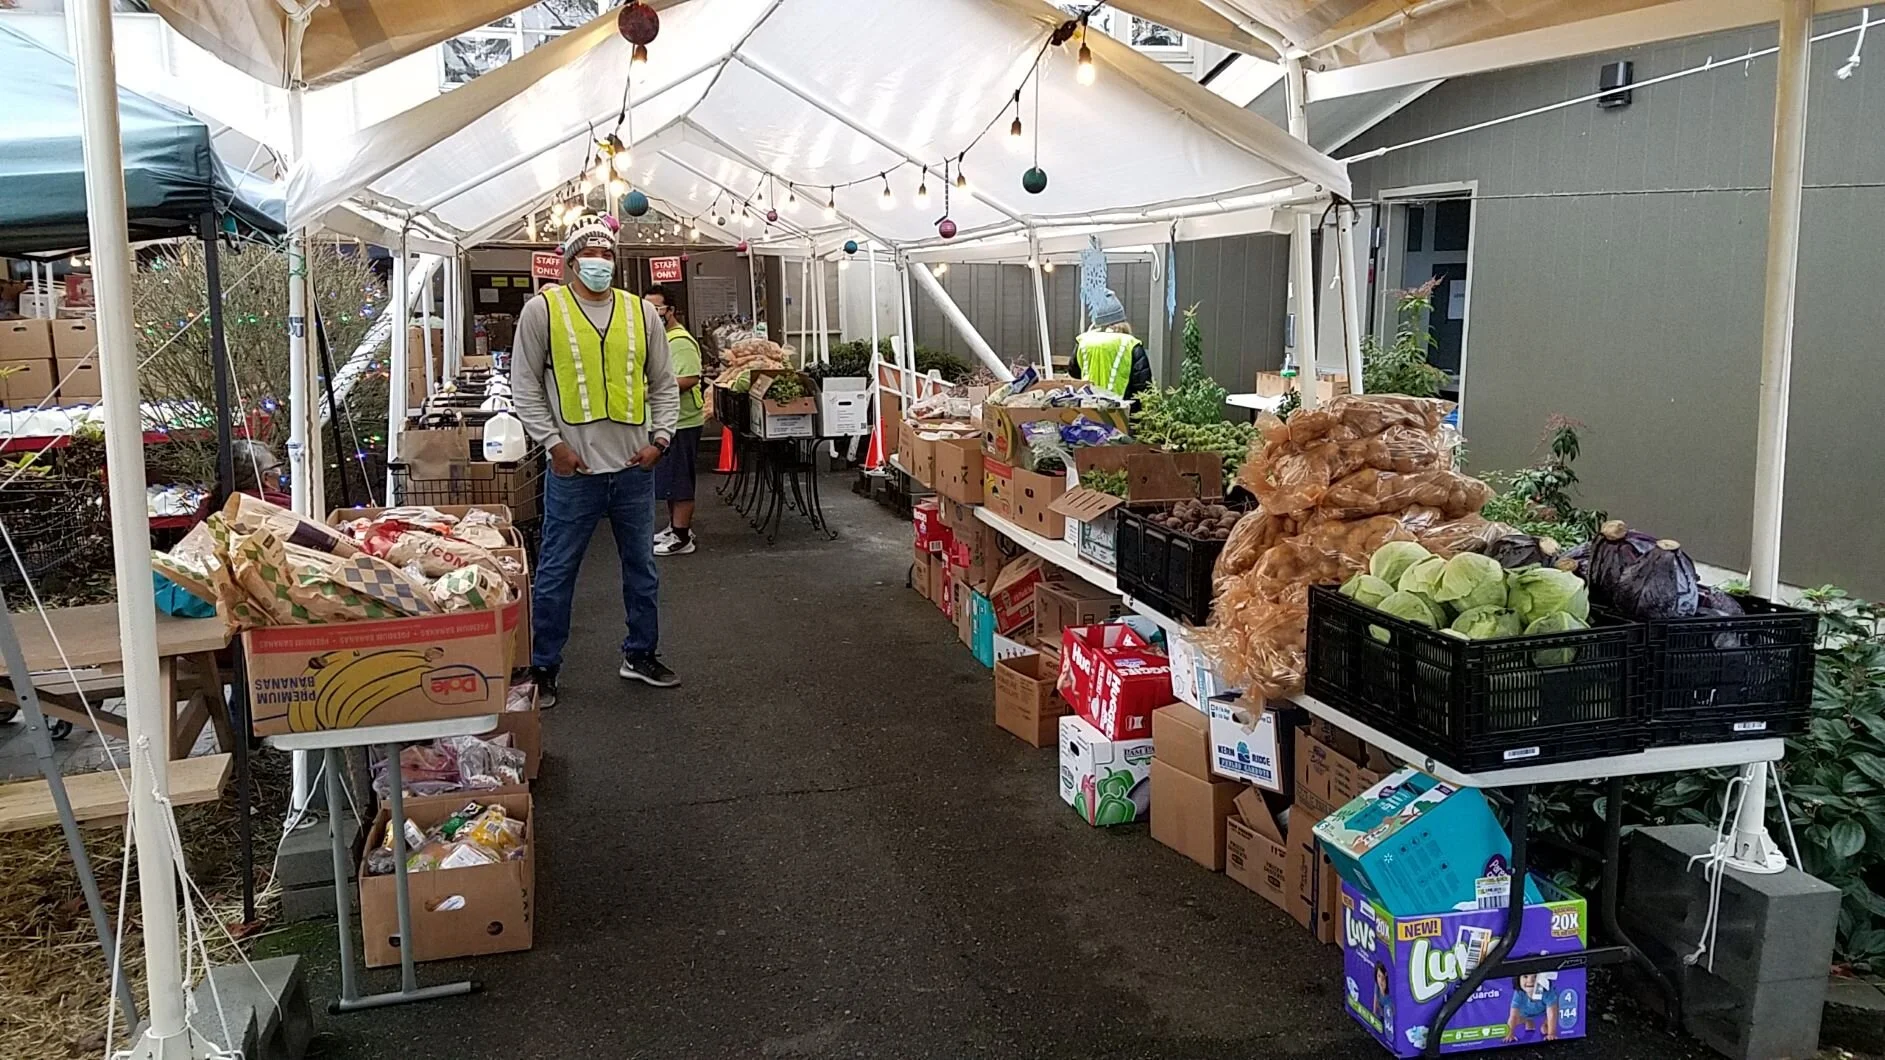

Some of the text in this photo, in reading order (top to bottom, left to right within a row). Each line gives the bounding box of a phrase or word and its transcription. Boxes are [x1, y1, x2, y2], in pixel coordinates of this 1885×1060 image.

[536, 256, 561, 266] STAFF
[654, 260, 678, 270] STAFF
[537, 266, 560, 276] ONLY
[656, 270, 677, 279] ONLY
[254, 676, 316, 690] BANANAS
[431, 676, 477, 696] Dole
[256, 690, 316, 705] PREMIUM
[1551, 913, 1579, 931] 20X
[1404, 919, 1438, 938] NEW!
[1564, 992, 1572, 1003] 4
[1559, 1008, 1577, 1019] 144
